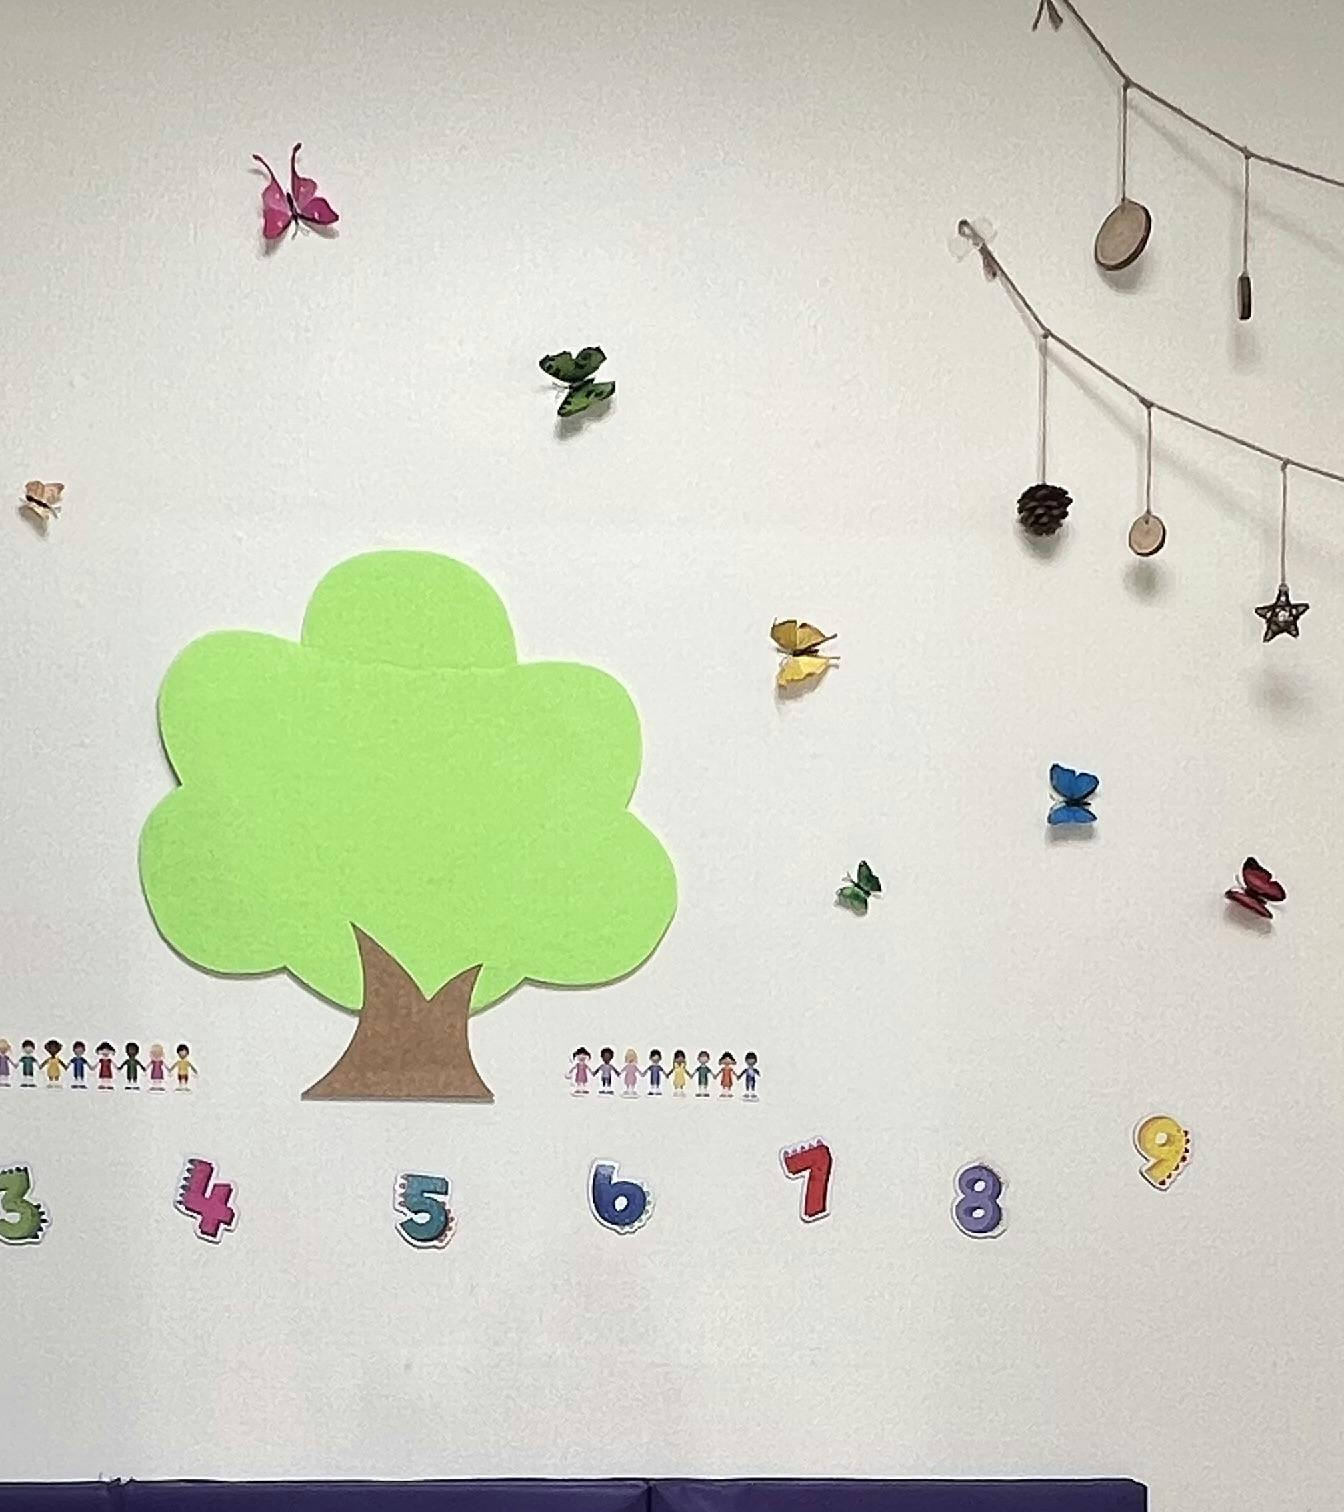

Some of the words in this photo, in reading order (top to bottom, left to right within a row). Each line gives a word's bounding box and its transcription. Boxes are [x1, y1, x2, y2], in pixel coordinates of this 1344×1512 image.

[175, 1157, 240, 1242] 4
[396, 1172, 454, 1248] 5
[589, 1161, 651, 1233] 6
[779, 1138, 833, 1222] 7
[953, 1165, 1007, 1239] 8
[1134, 1113, 1190, 1190] 9
